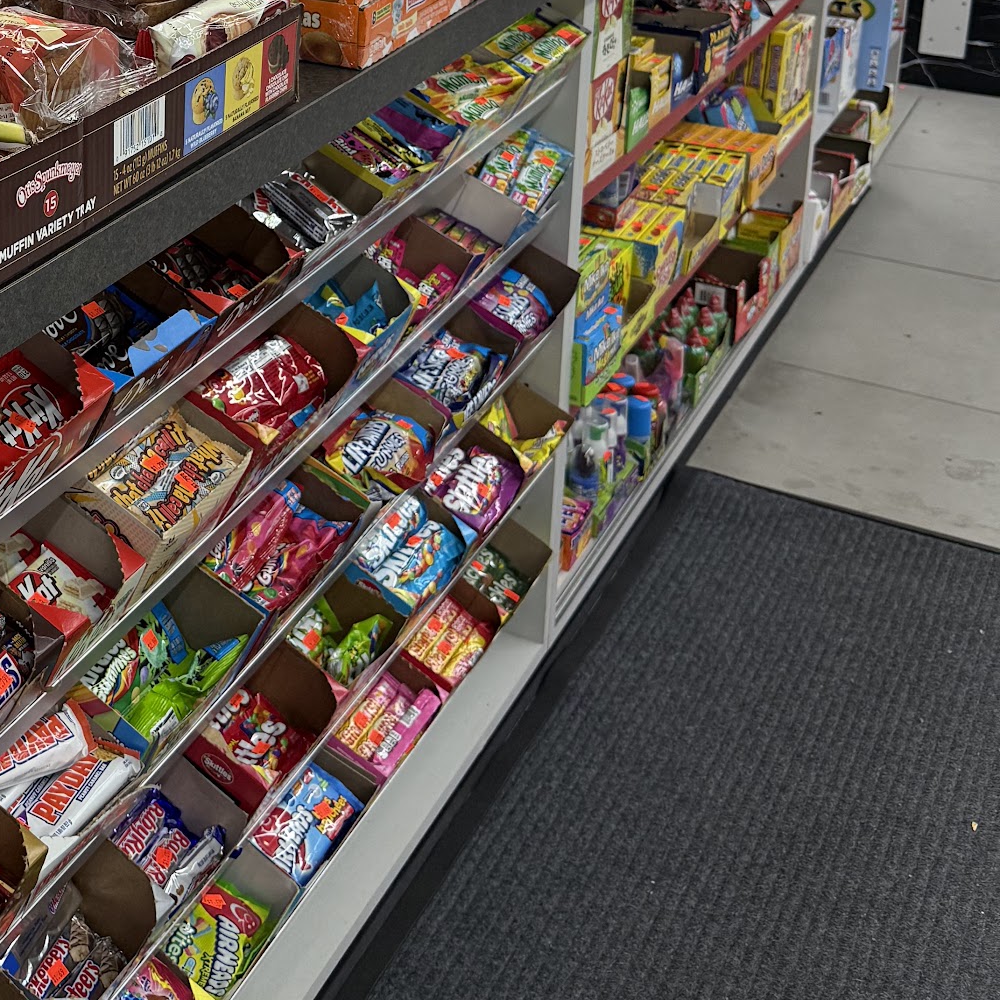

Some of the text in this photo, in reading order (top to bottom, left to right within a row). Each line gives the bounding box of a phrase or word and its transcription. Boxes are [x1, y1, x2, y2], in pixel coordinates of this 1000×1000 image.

[35, 159, 83, 194] Spunkmeyer
[36, 211, 75, 242] VARIETY
[74, 195, 98, 220] TRAY
[44, 194, 57, 213] 15
[203, 756, 233, 783] Skittles
[204, 914, 241, 998] AIRHEADS
